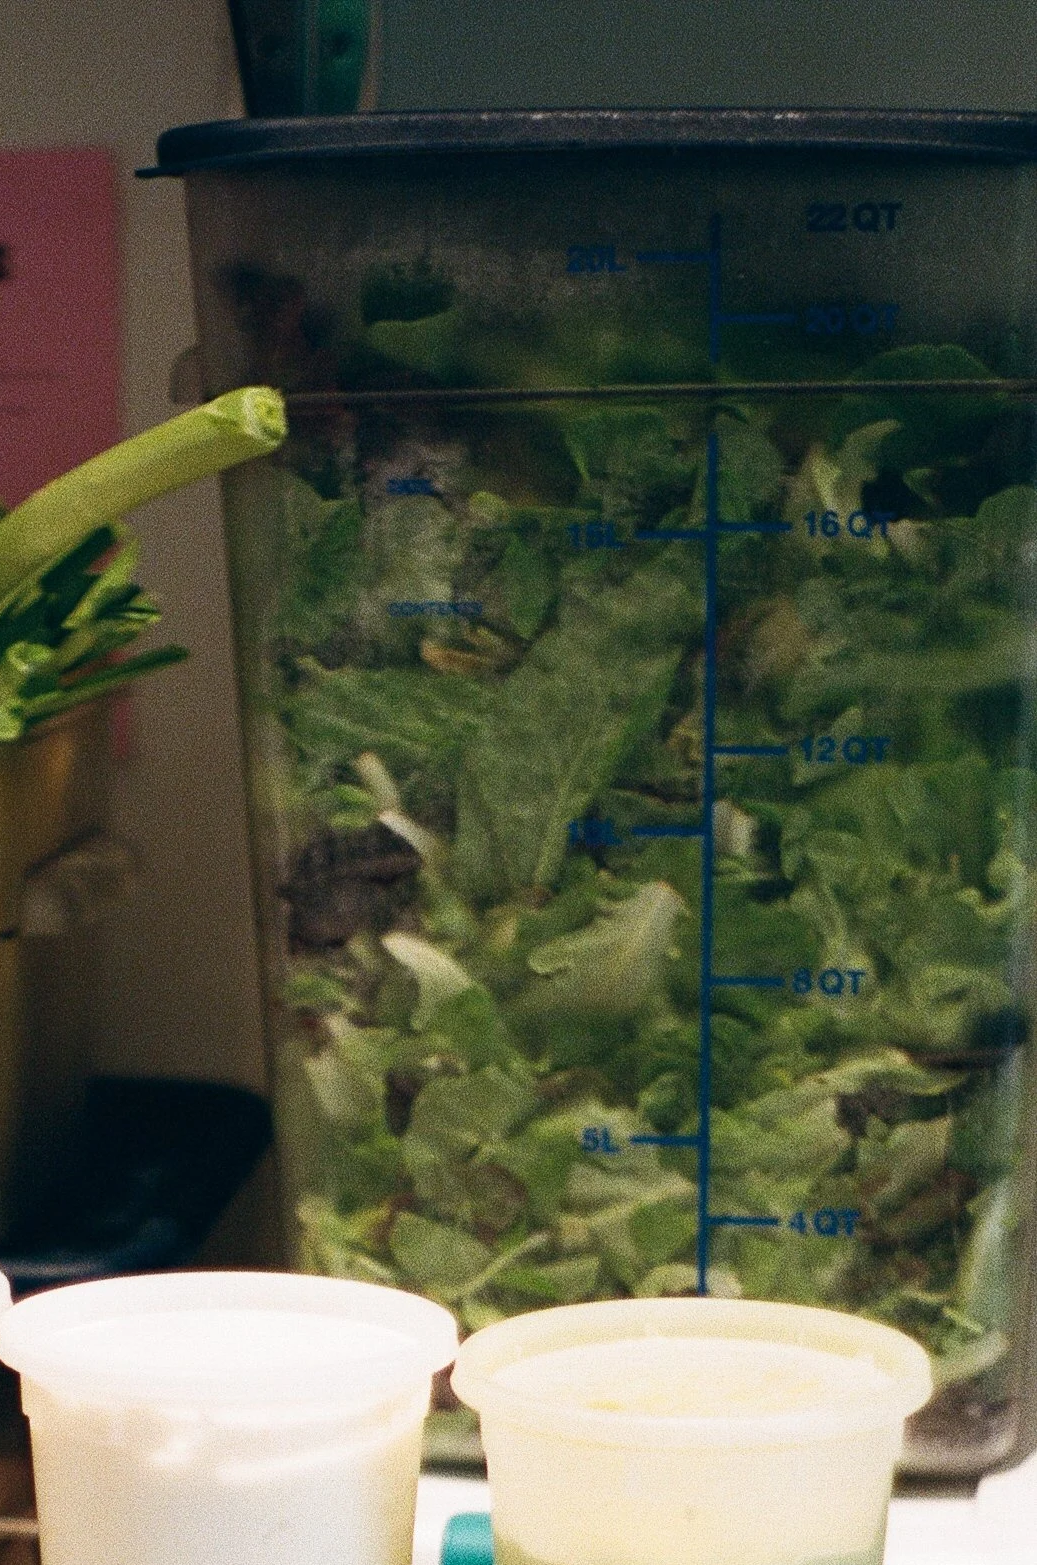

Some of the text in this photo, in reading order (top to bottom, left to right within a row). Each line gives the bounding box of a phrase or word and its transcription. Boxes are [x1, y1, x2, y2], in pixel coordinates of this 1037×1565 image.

[852, 202, 903, 232] QT
[803, 510, 899, 539] 16 QT
[799, 736, 891, 764] 12 QT
[817, 968, 865, 995] QT
[581, 1127, 621, 1155] 5L
[813, 1208, 861, 1236] QT
